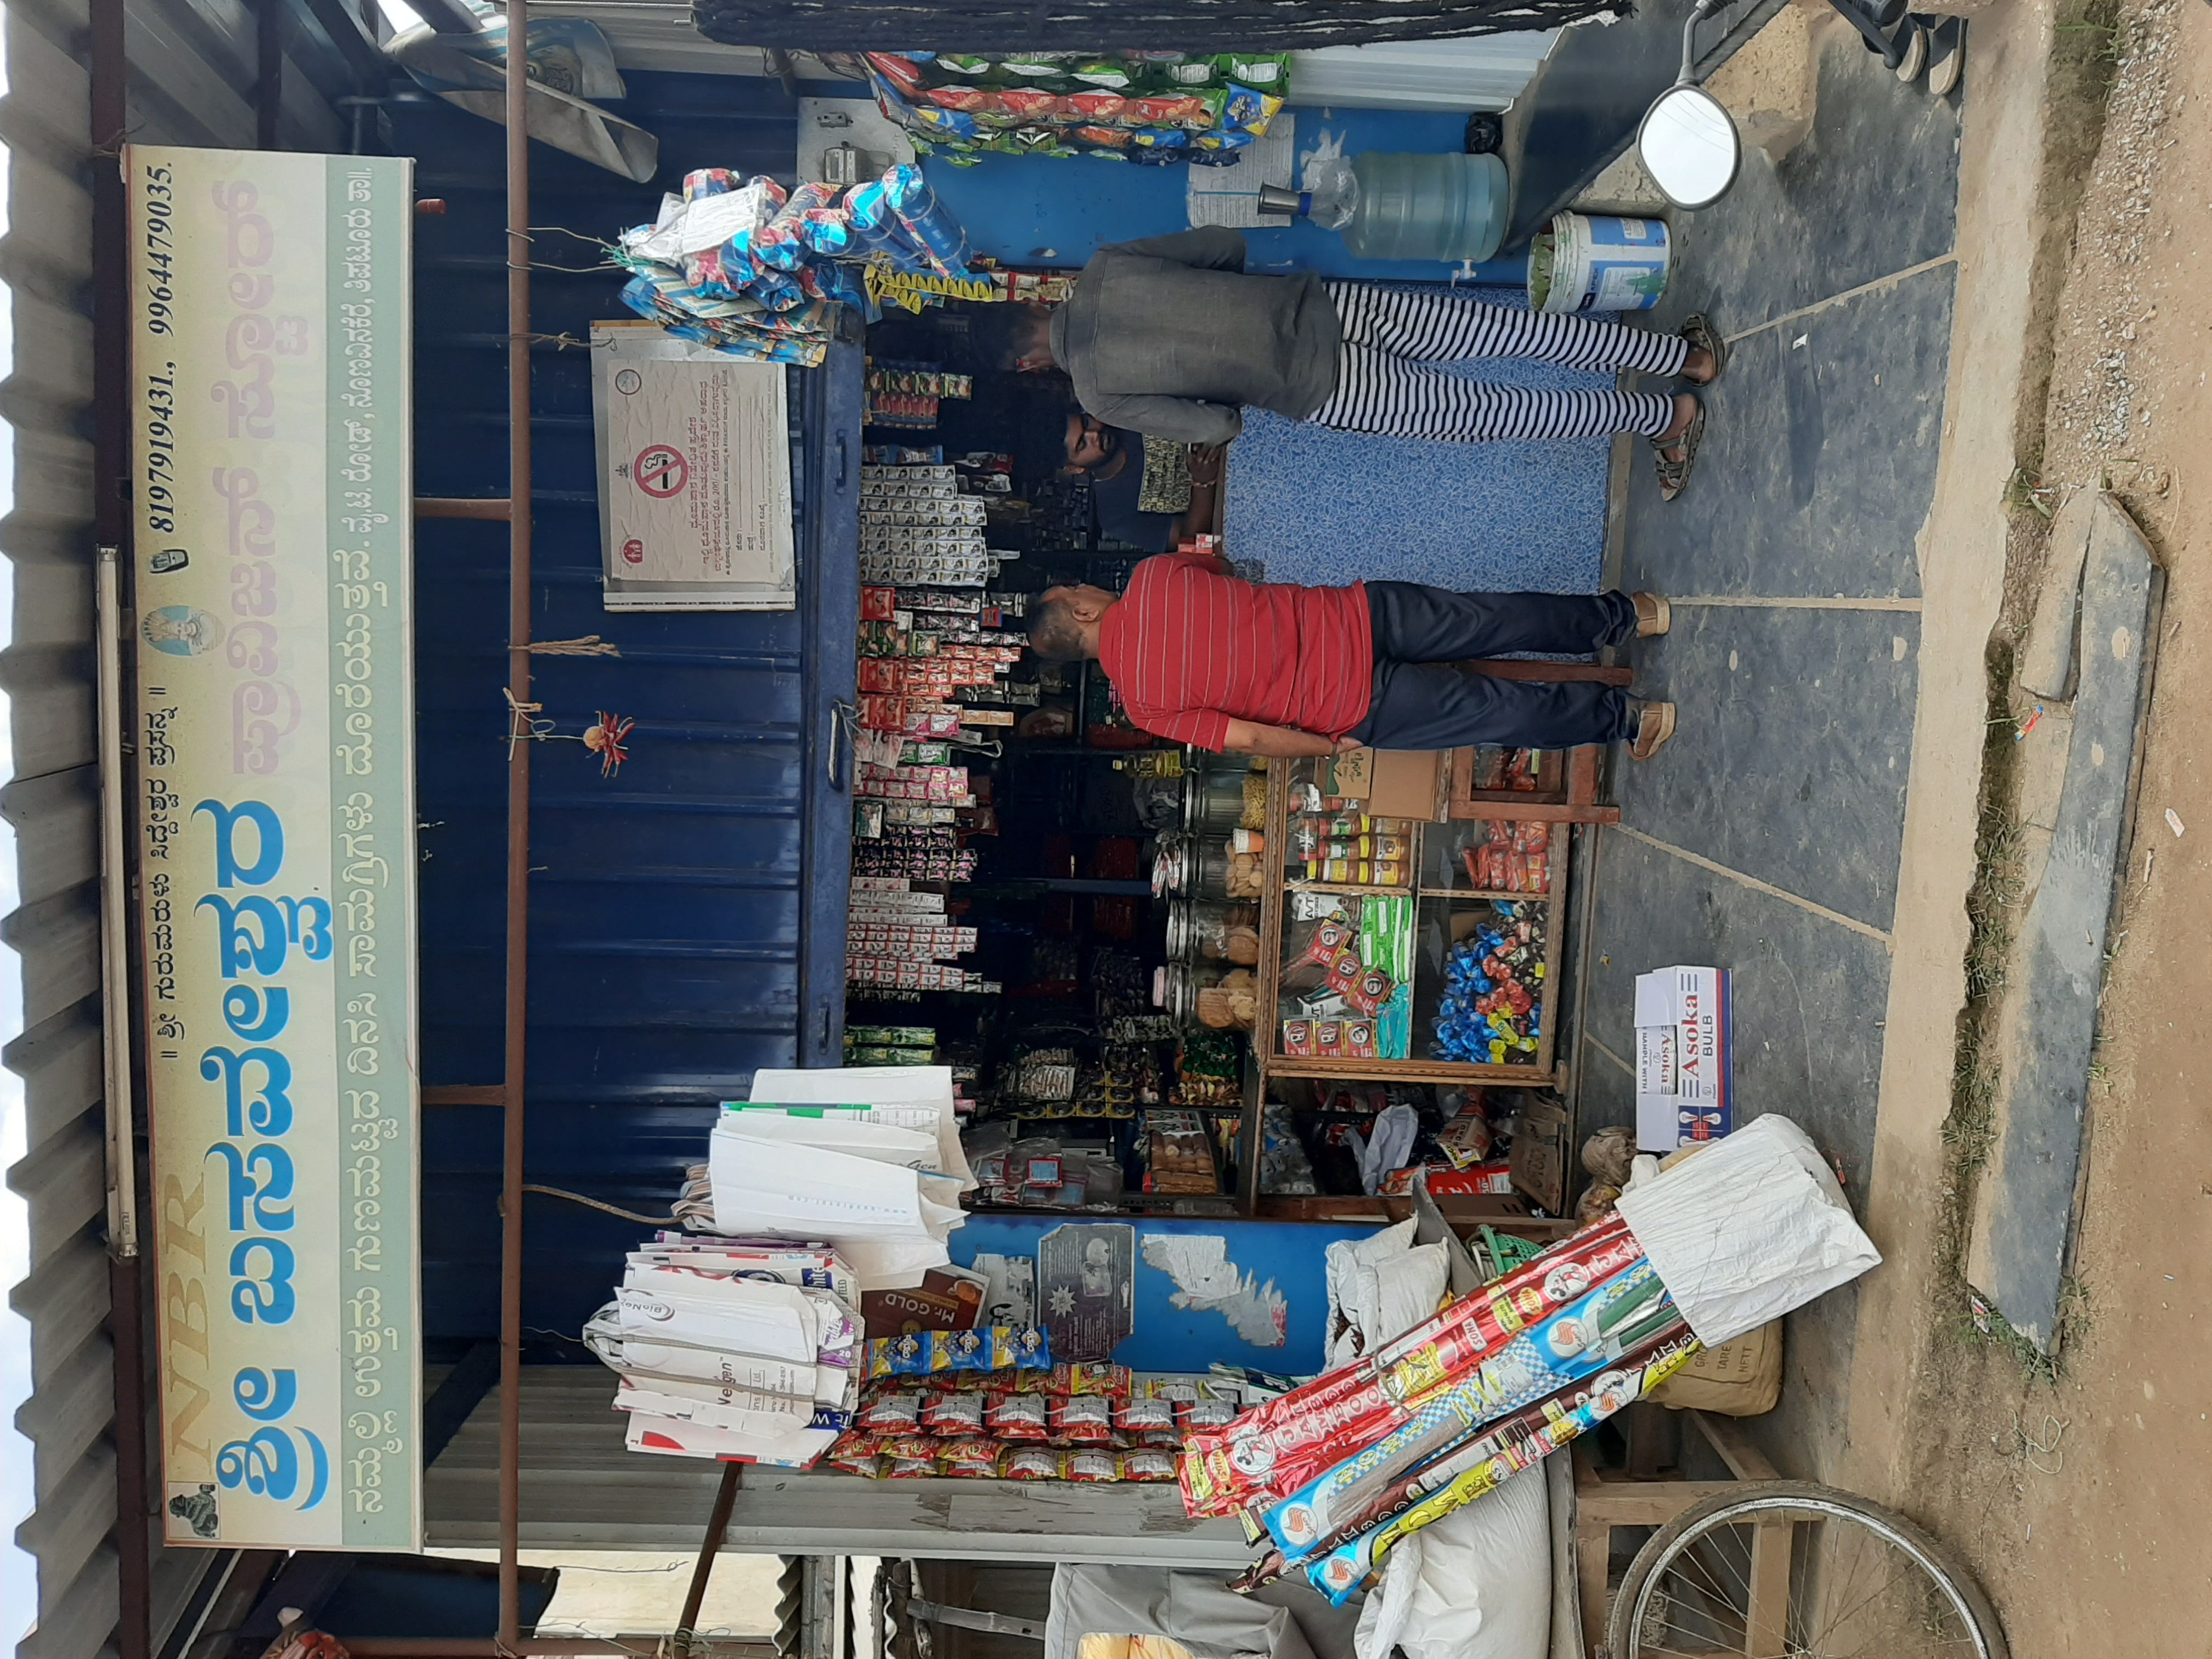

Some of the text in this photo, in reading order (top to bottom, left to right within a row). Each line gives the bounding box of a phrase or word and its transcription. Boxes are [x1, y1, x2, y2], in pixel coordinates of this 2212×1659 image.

[341, 207, 373, 293] ತಿಪಟೂರು
[145, 706, 178, 766] ಪ್ರಸನ್ನ
[190, 180, 334, 1511] ಶ್ರೀ ಬಸವೇಶ್ವರ ಪ್ರಾವಿಜನ್ ಸ್ಟೋರ್
[337, 792, 389, 977] ಸಾಮಗ್ರಿಗಳು
[1305, 896, 1314, 918] AVT
[156, 1013, 184, 1040] ಶ್ರೀ
[342, 993, 380, 1075] ದಿನಸಿ
[1681, 994, 1700, 1079] Asoka
[1702, 1015, 1713, 1057] BULB
[1661, 1032, 1671, 1084] Asoka
[344, 1090, 399, 1271] ಗುಣಮಟ್ಟದ
[163, 1172, 212, 1476] NBR
[884, 1293, 931, 1315] GOLD
[934, 1306, 955, 1323] Mr.
[1464, 1320, 1482, 1346] SONA
[346, 1286, 399, 1397] ಉತ್ತಮ
[1717, 1345, 1732, 1369] TARE
[1738, 1346, 1753, 1373] NETT
[347, 1410, 403, 1514] ನಮ್ಮಲ್ಲಿ
